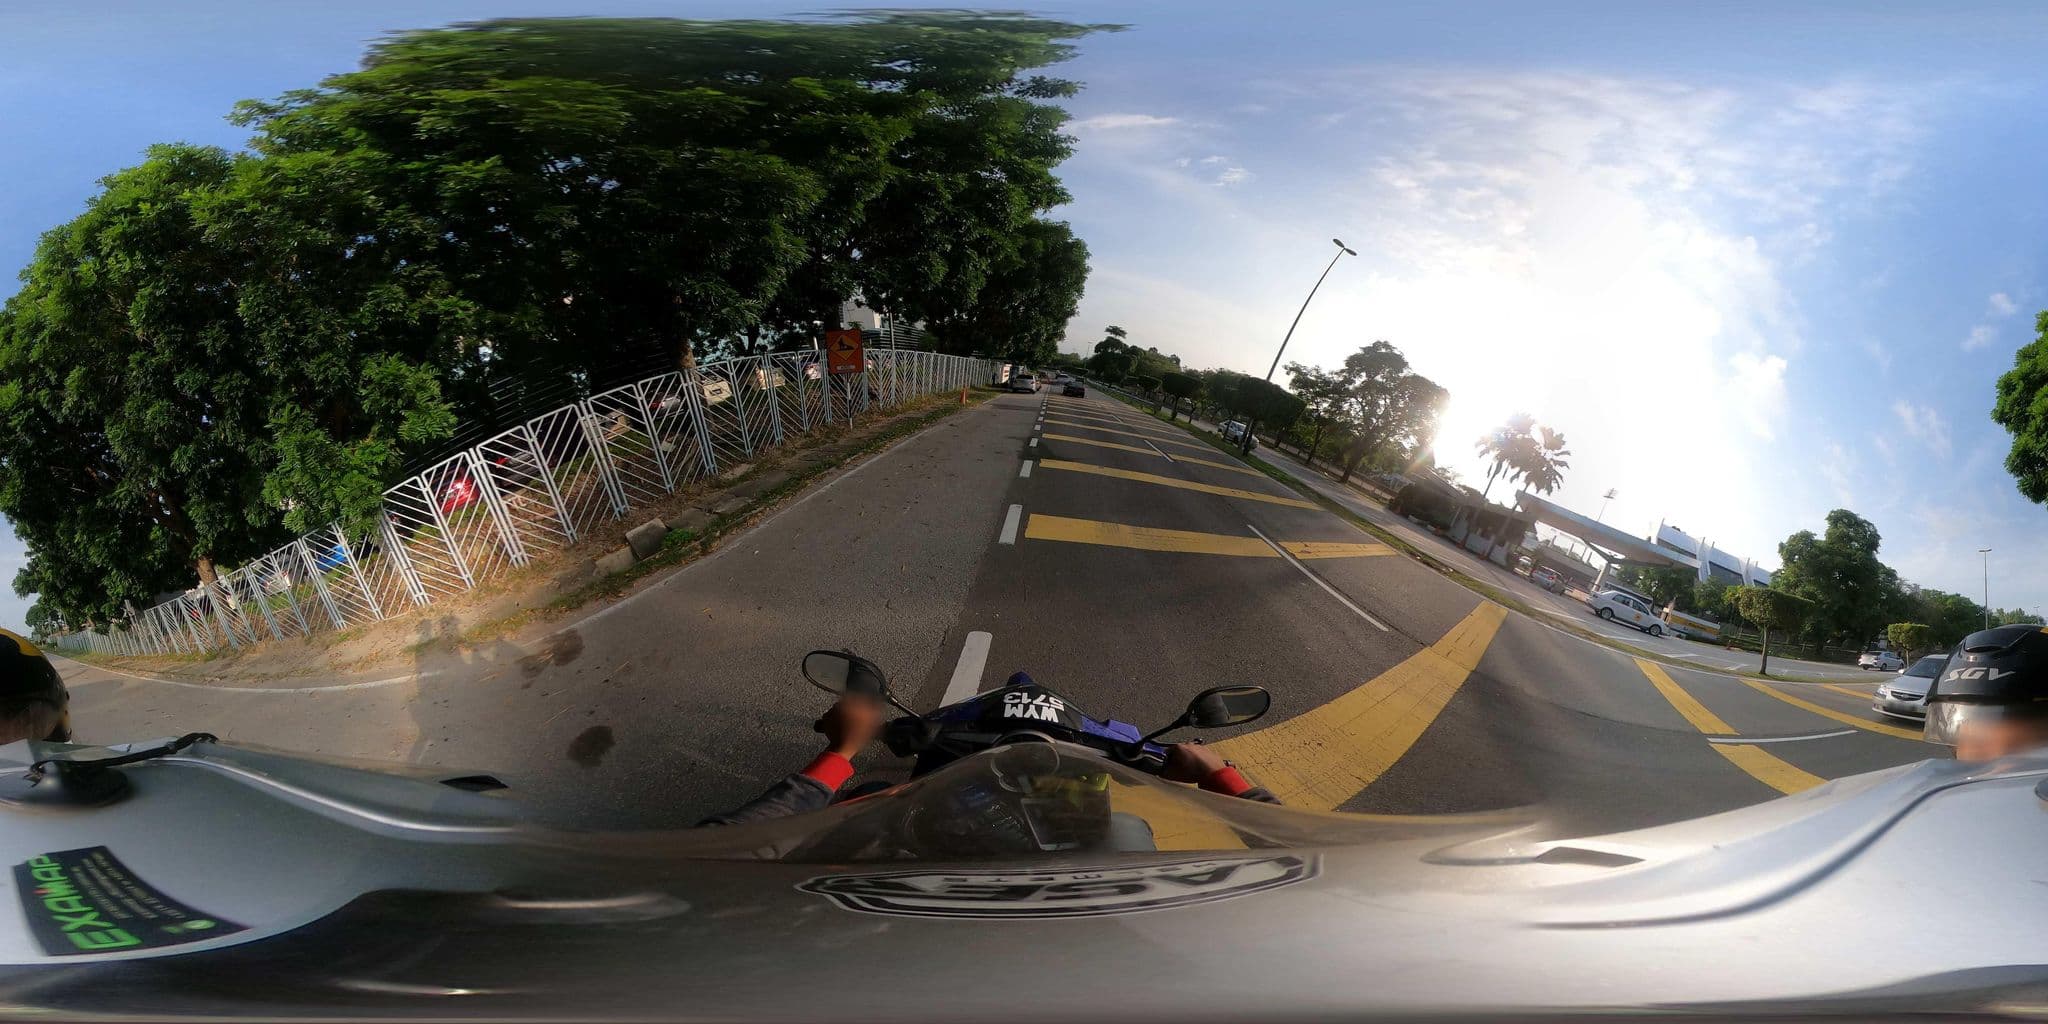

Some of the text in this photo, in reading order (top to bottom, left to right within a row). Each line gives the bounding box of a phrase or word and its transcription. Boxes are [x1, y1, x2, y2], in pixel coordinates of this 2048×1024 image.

[1944, 667, 2015, 682] SGV
[1003, 692, 1064, 711] 5713
[1004, 704, 1058, 723] WYM
